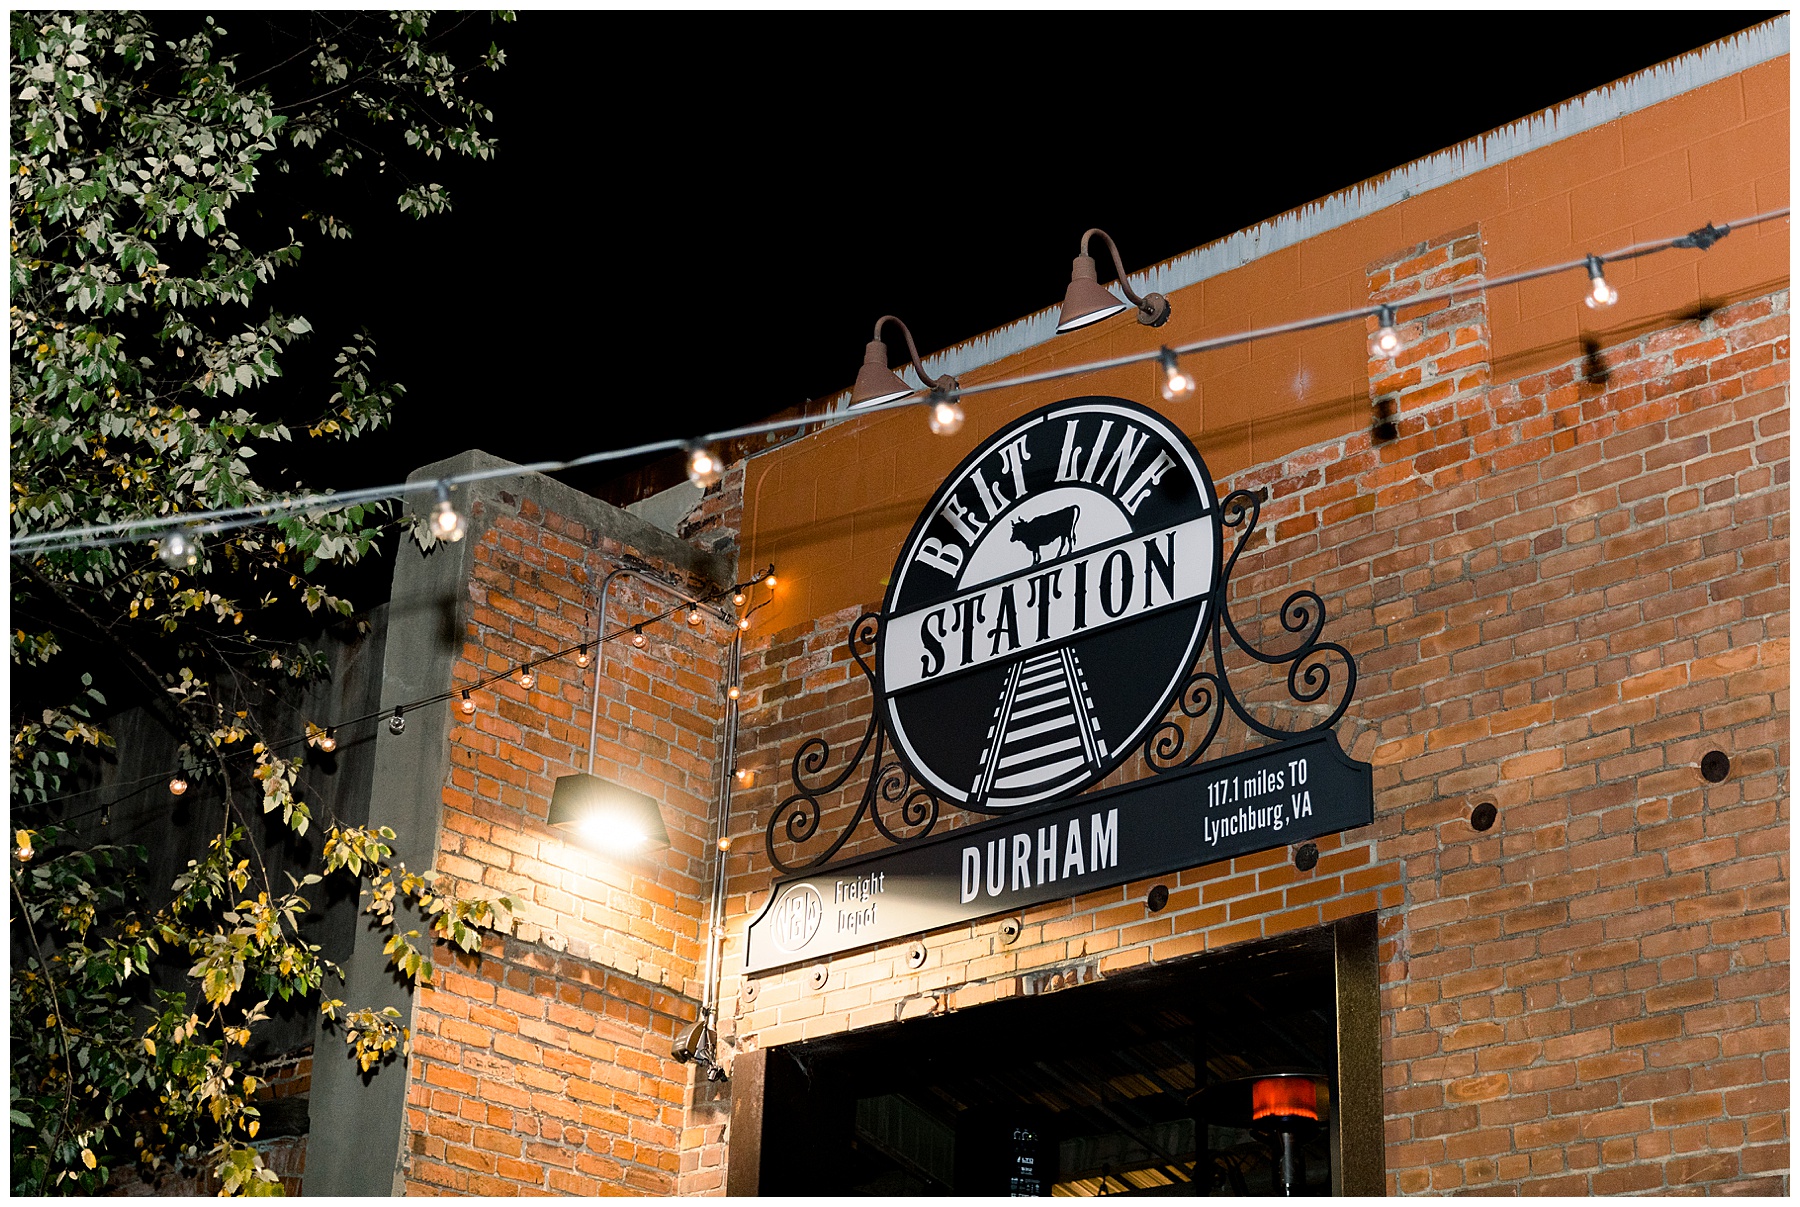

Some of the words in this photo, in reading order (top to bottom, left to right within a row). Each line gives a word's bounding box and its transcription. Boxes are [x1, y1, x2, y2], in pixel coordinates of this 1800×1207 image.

[914, 434, 1032, 579] BELT
[1054, 419, 1177, 516] LINE
[920, 531, 1177, 679] STATION
[1207, 776, 1239, 808] 117.1
[1244, 769, 1285, 799] miles
[1288, 758, 1307, 787] TO
[1204, 803, 1290, 847] Lynchburg,
[1291, 790, 1313, 820] VA
[960, 808, 1119, 905] DURHAM
[834, 871, 885, 905] Freight
[837, 902, 878, 935] Depot
